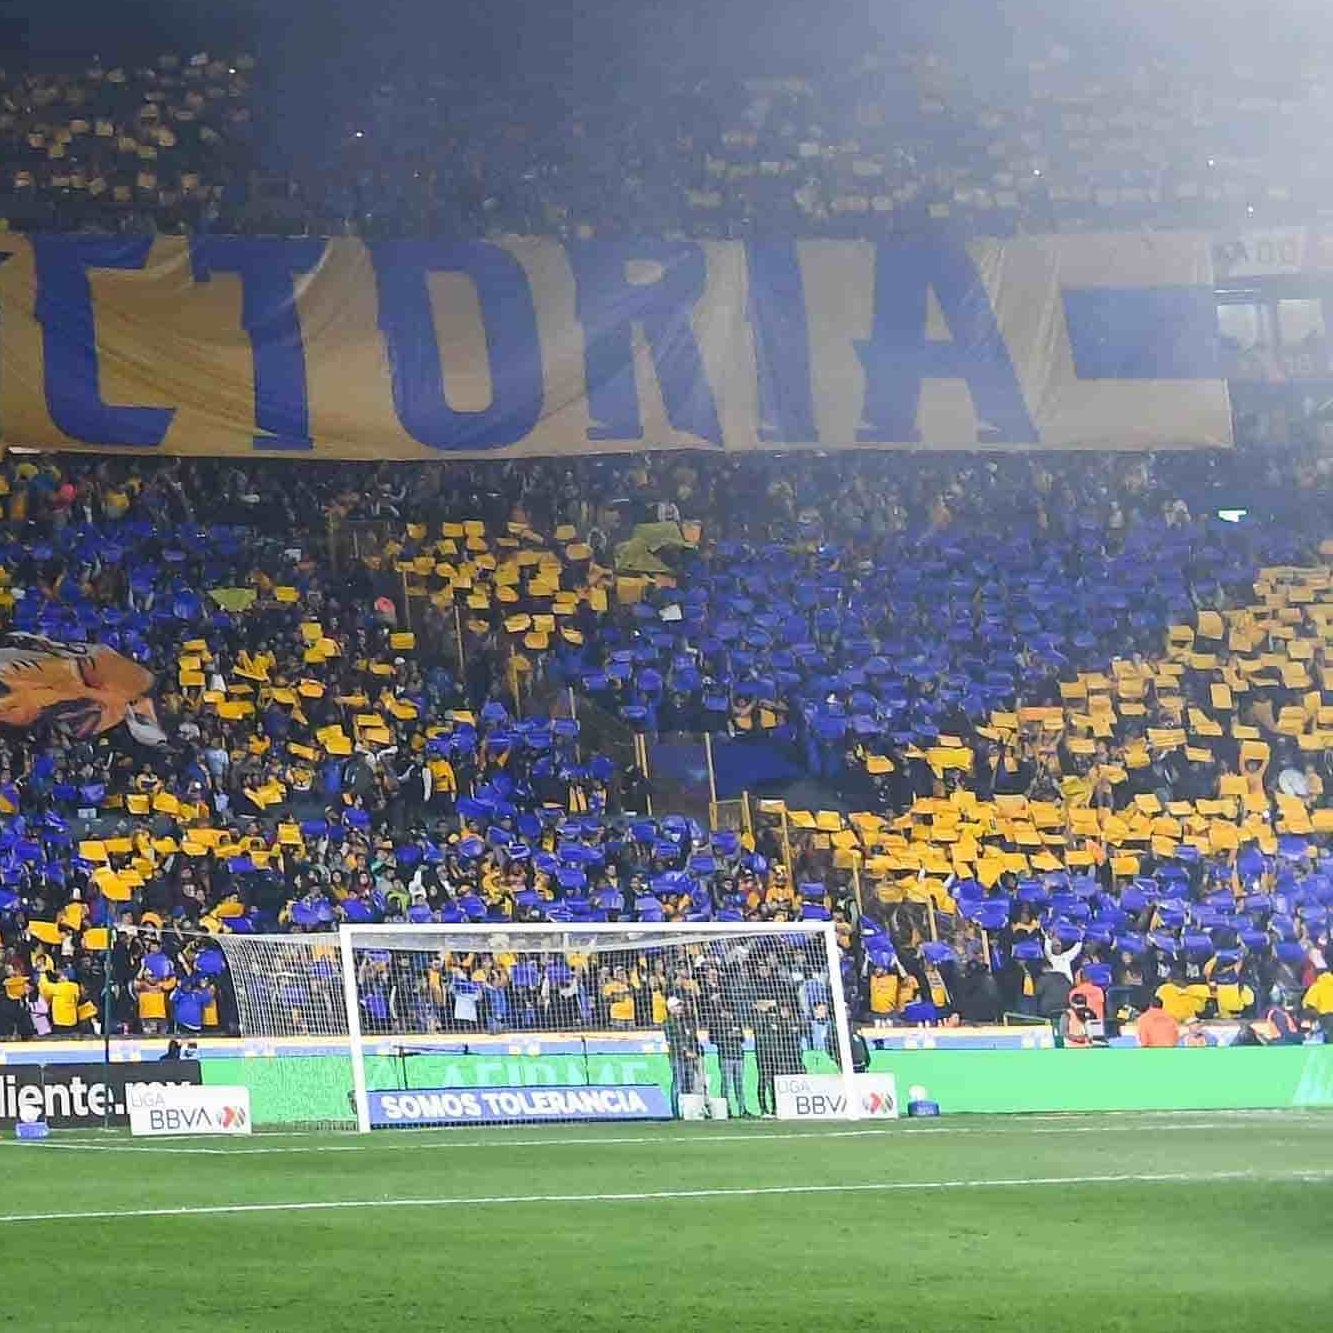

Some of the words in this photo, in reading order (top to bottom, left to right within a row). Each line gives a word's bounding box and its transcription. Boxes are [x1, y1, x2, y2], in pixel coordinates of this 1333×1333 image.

[381, 1093, 481, 1119] SOMOS
[483, 1090, 648, 1116] TOLERANCIA
[150, 1107, 212, 1130] BBVA
